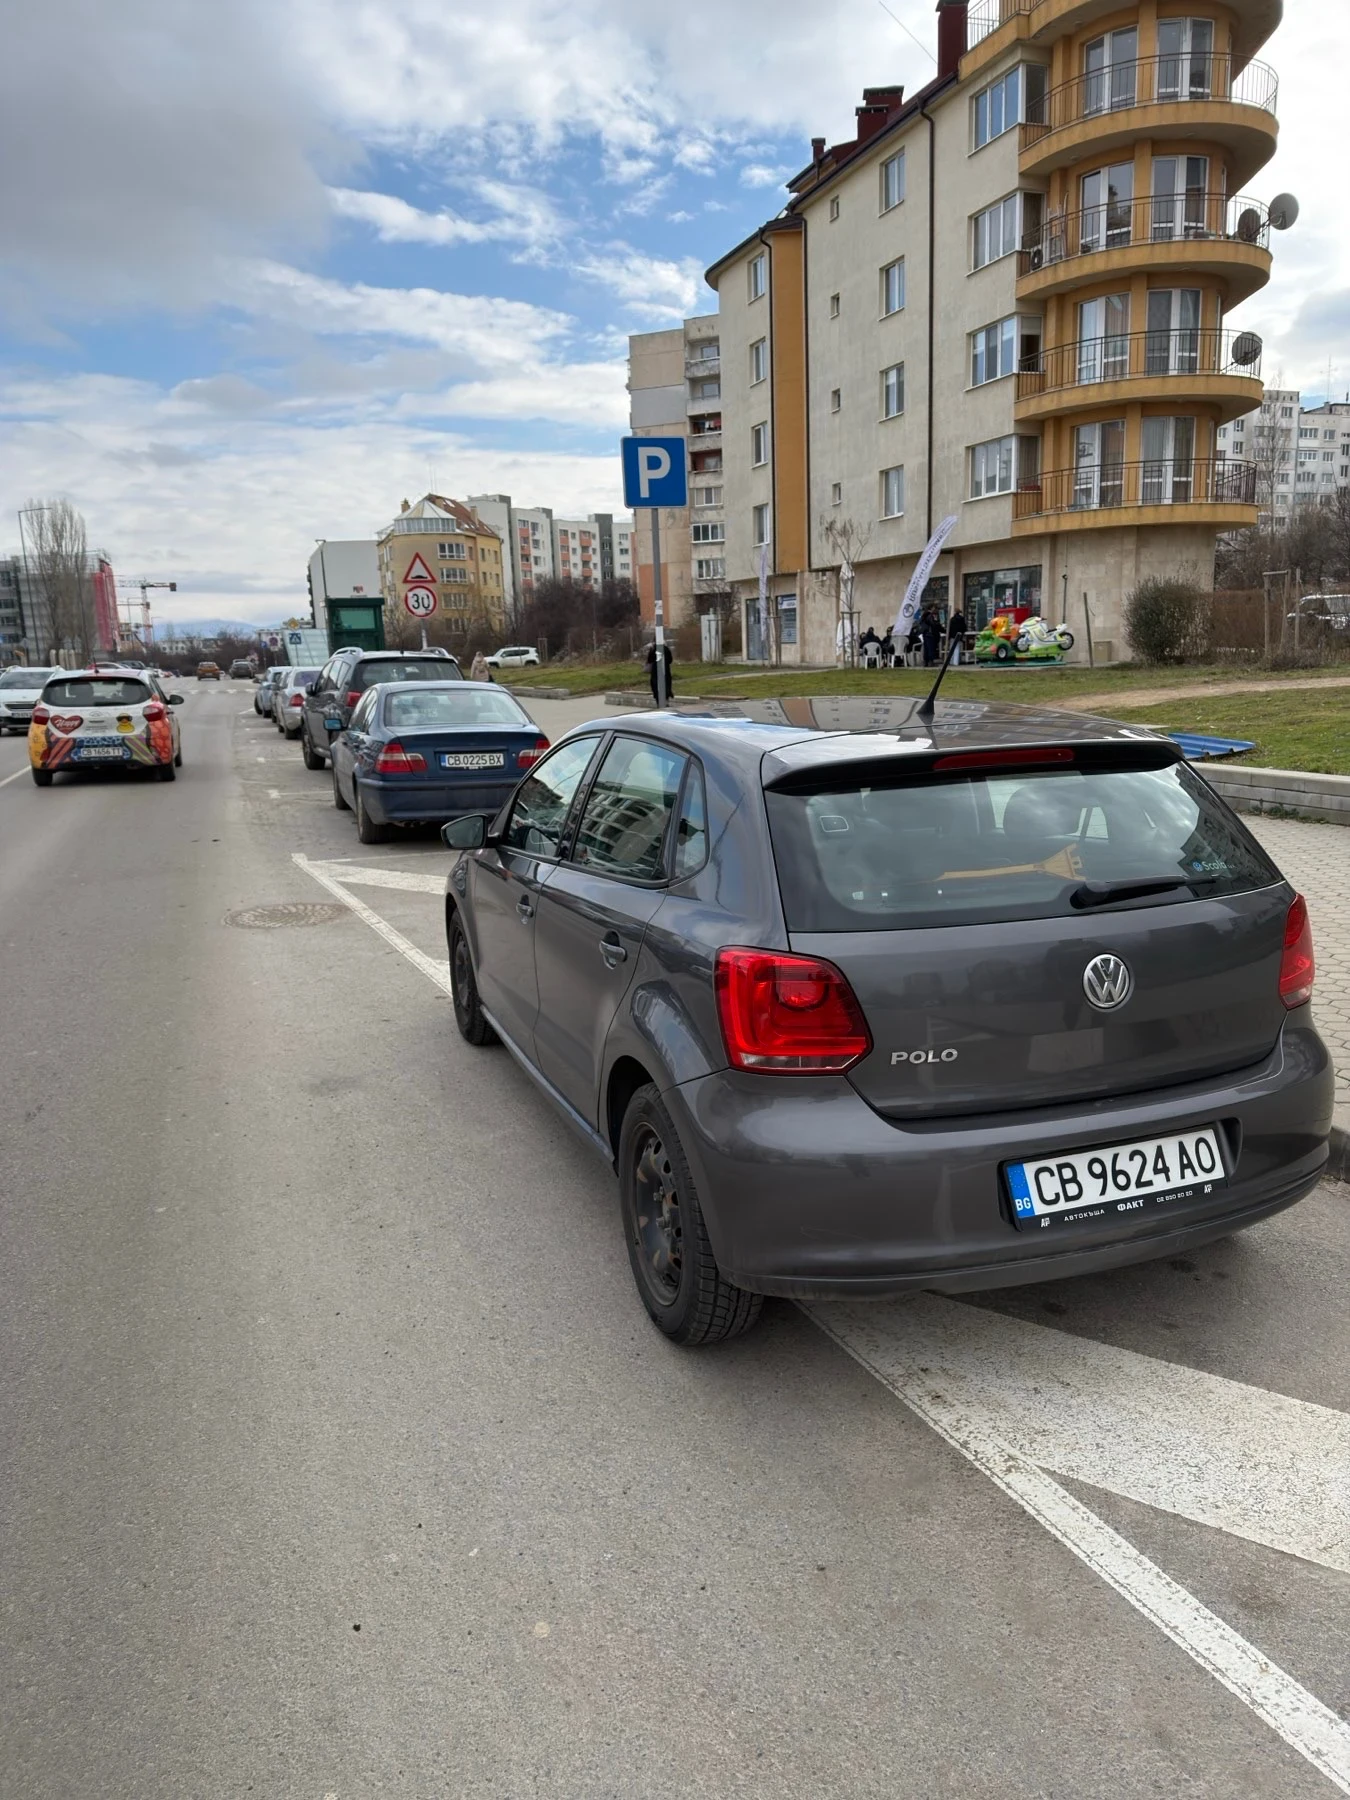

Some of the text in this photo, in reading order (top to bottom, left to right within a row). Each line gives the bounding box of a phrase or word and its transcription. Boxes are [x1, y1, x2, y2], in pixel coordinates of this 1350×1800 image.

[638, 446, 671, 498] P
[412, 593, 431, 610] 30
[890, 1048, 958, 1065] POLO
[1015, 1197, 1031, 1212] BG
[1117, 1199, 1144, 1211] ФАКТ
